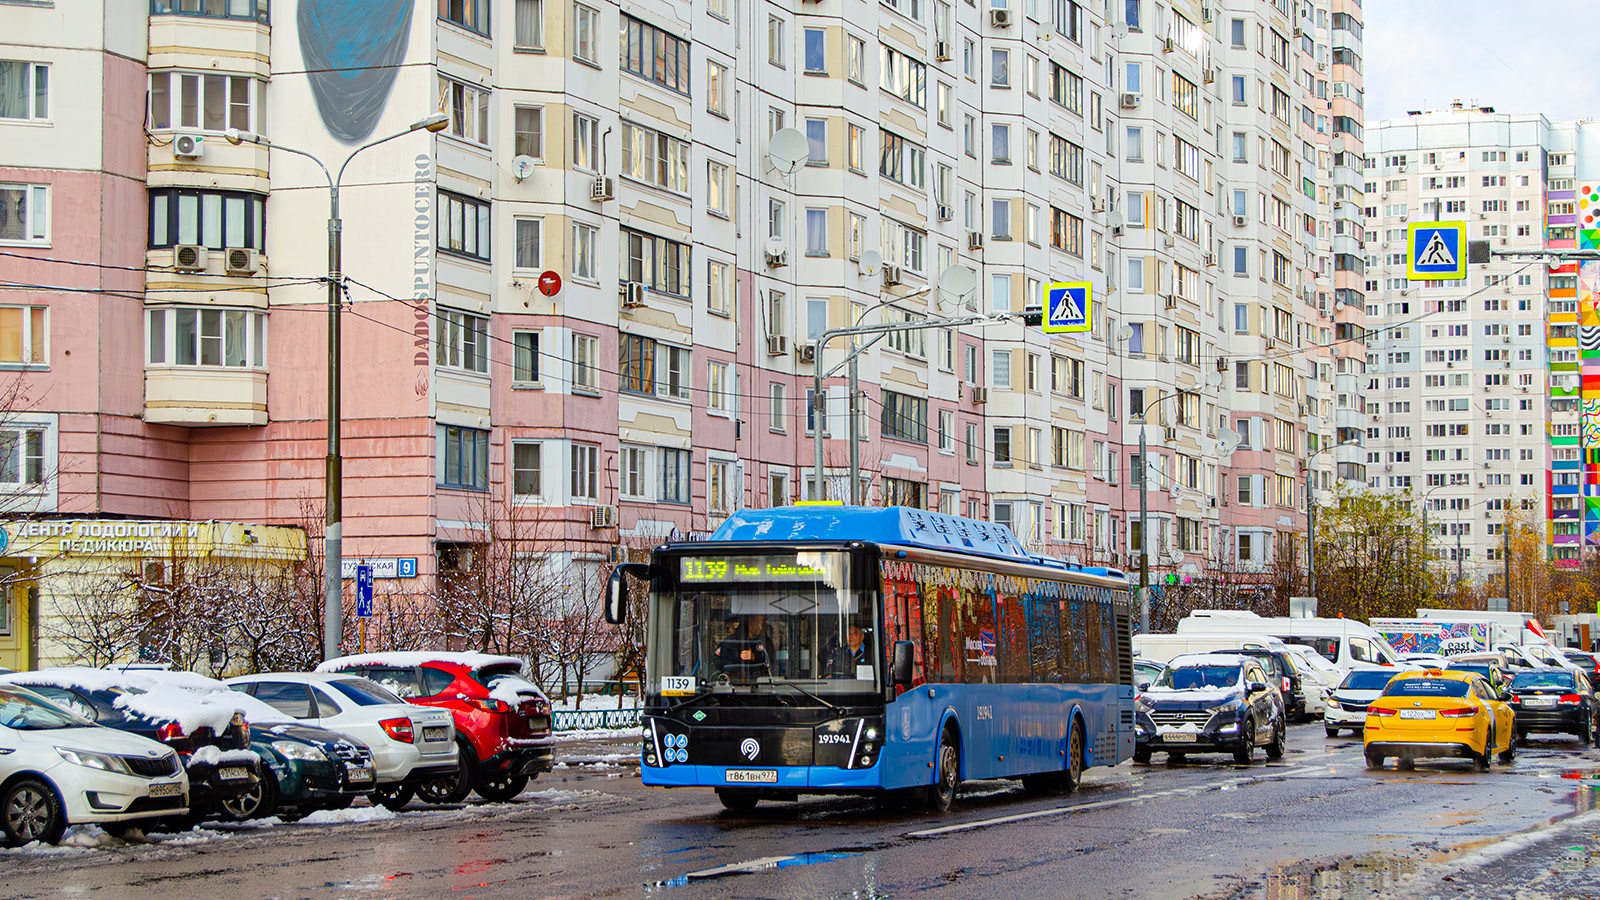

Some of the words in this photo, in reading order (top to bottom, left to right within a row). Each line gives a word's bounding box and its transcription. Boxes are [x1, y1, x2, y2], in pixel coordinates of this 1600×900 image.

[414, 153, 430, 366] DADOSPUNTOCERO
[17, 523, 72, 539] ЦЕНТР
[78, 523, 184, 538] ПОДОЛОГИИ
[60, 539, 154, 553] ПЕДИКЮРА
[403, 562, 410, 573] 9
[685, 561, 728, 579] 1139
[667, 678, 690, 689] 1139
[818, 734, 851, 744] 191941
